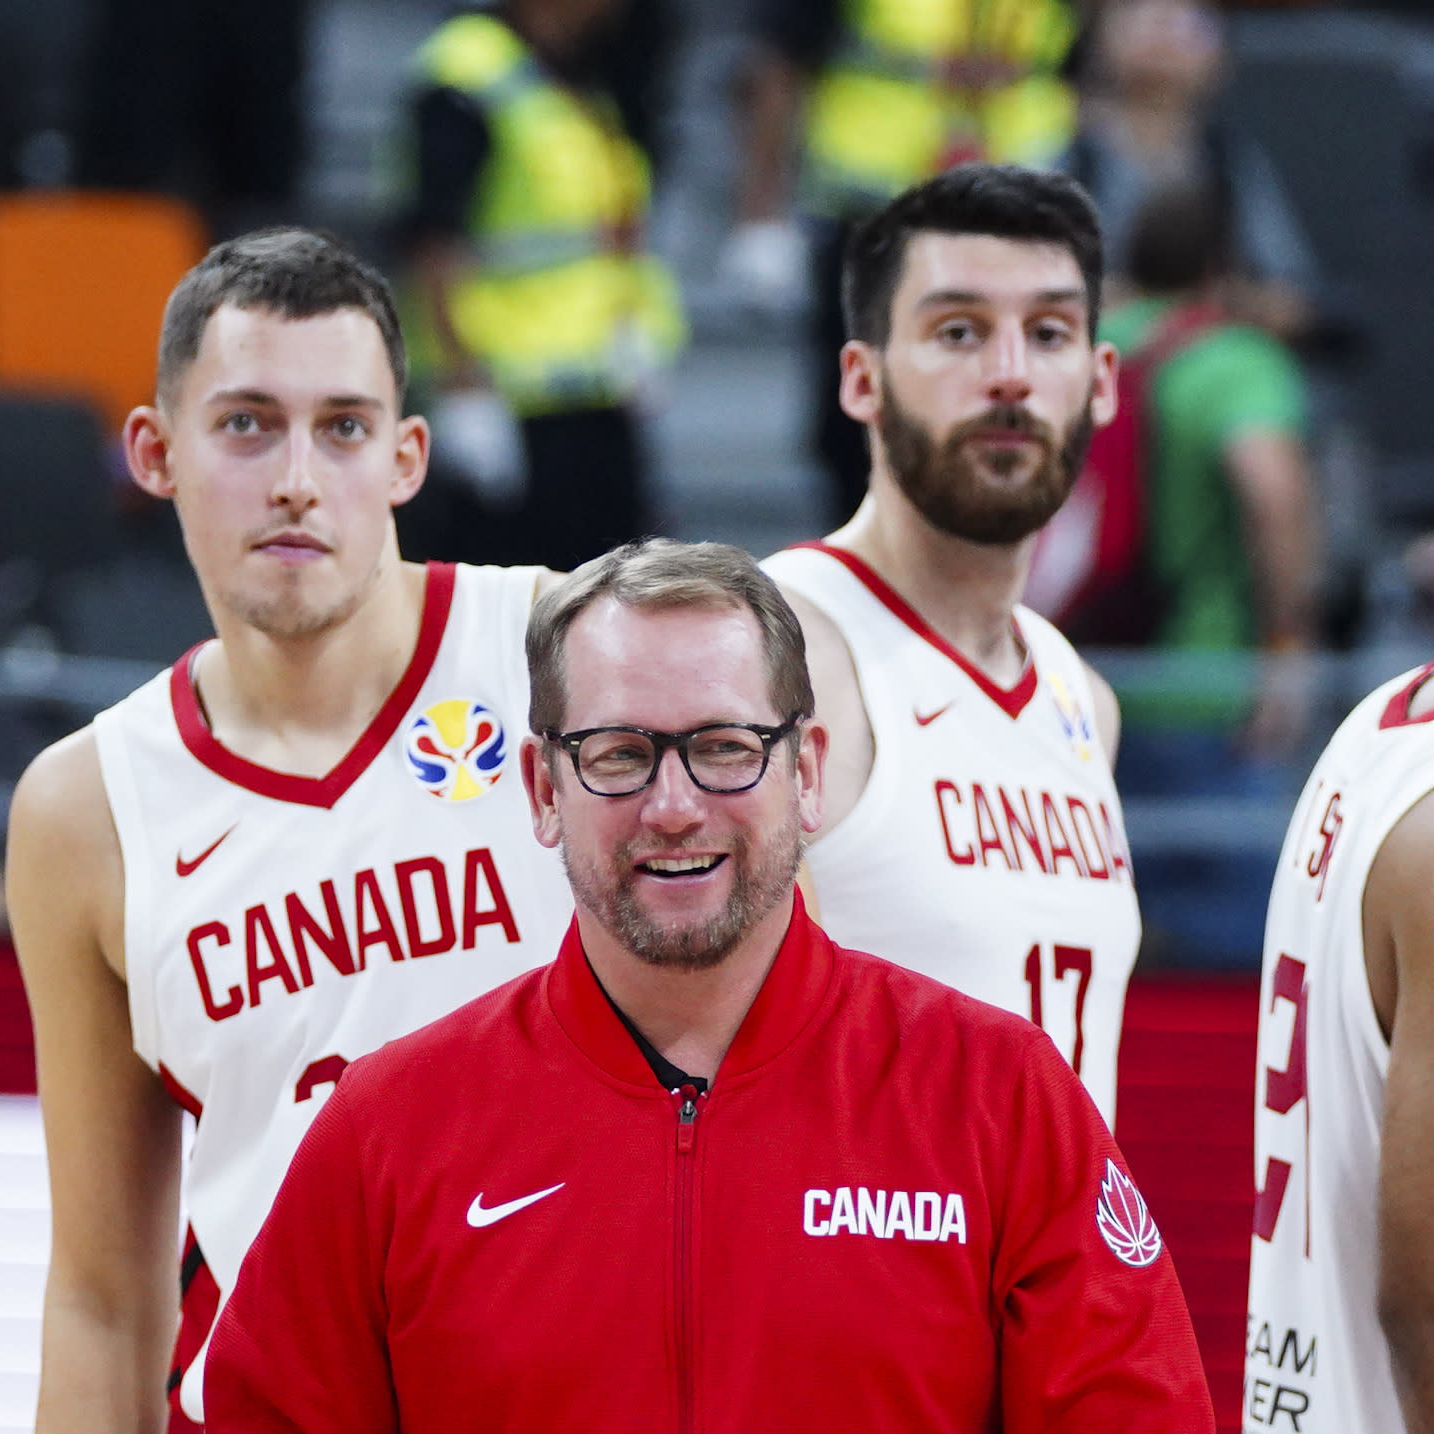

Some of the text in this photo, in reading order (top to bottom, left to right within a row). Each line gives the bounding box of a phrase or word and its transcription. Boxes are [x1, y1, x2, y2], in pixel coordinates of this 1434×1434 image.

[934, 779, 1132, 887] CANADA
[185, 847, 521, 1022] CANADA
[1024, 943, 1092, 1077] 17
[802, 1186, 967, 1245] CANADA
